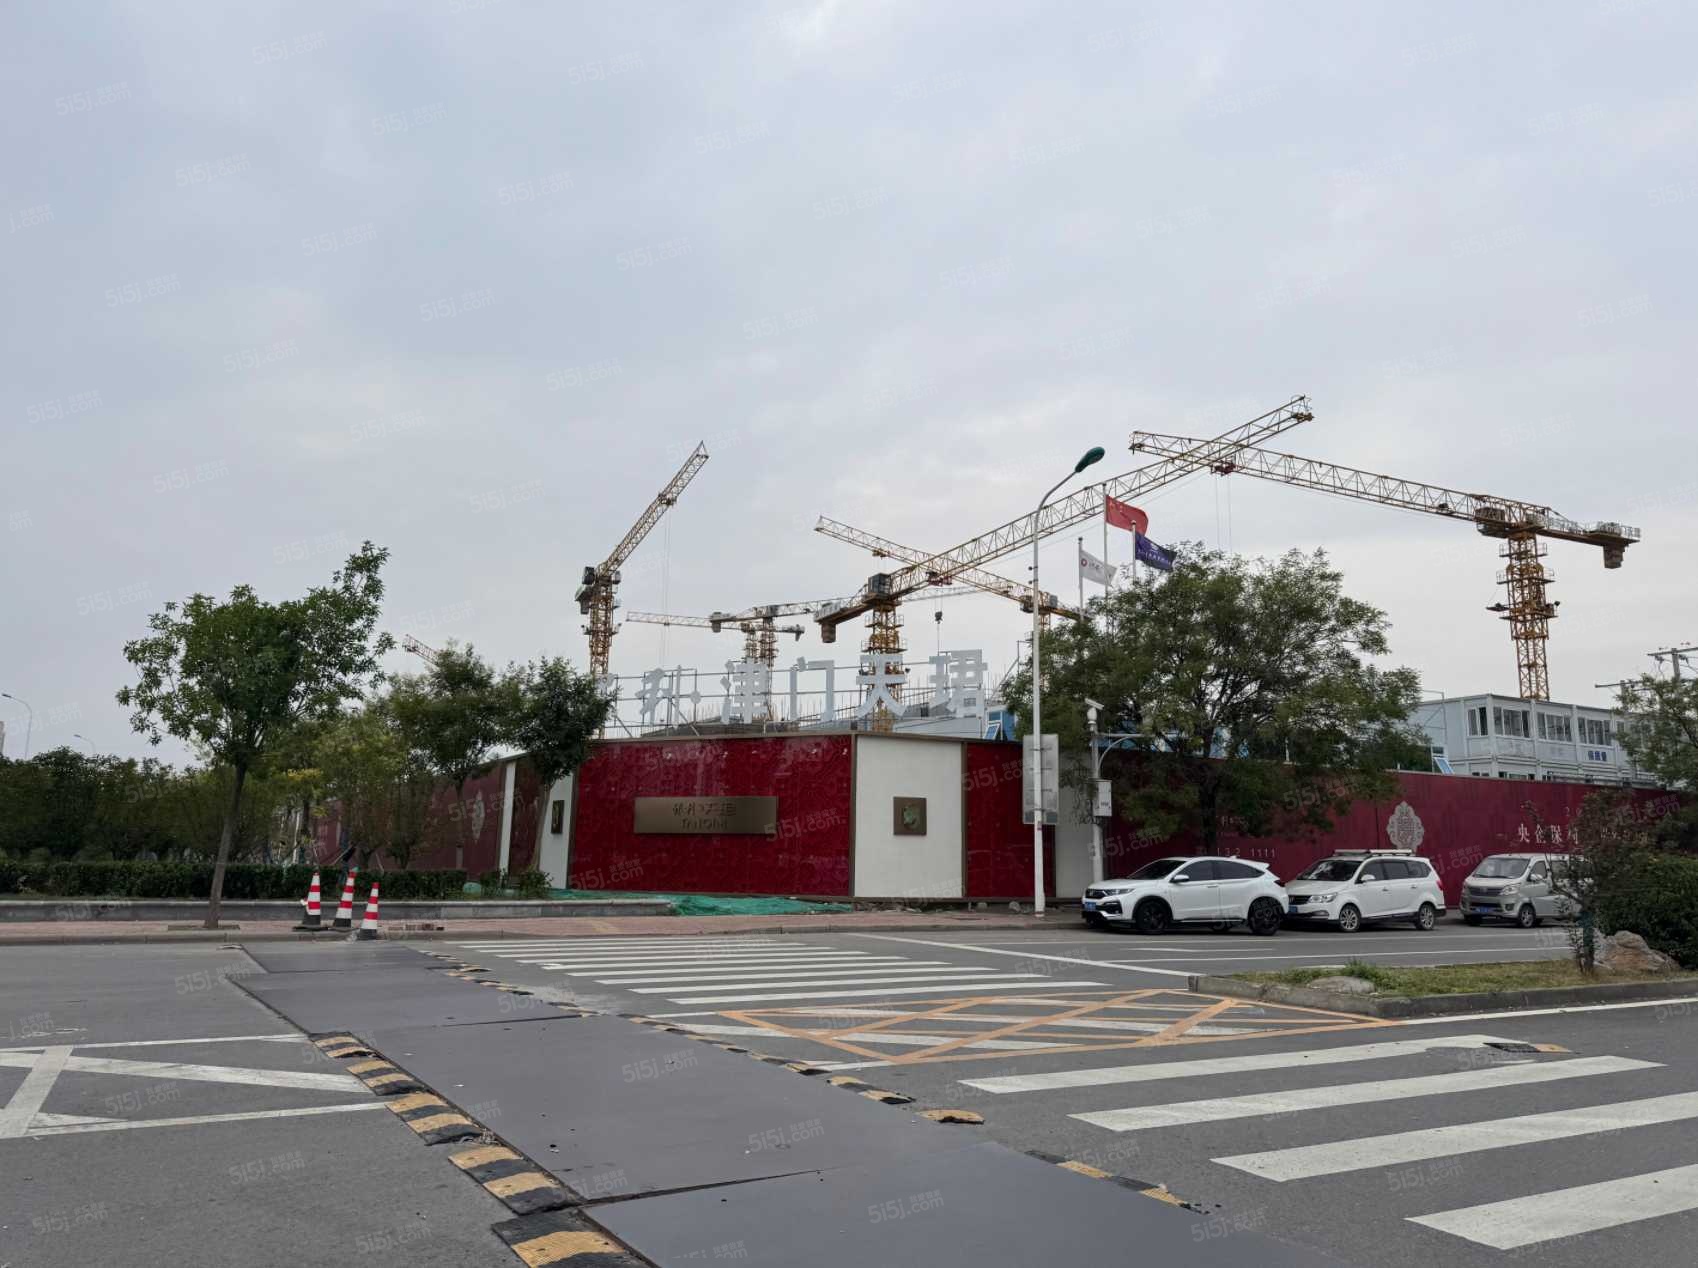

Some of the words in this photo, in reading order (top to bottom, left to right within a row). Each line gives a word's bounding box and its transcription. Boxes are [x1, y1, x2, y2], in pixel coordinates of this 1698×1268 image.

[595, 649, 988, 730] 利·津门天珺
